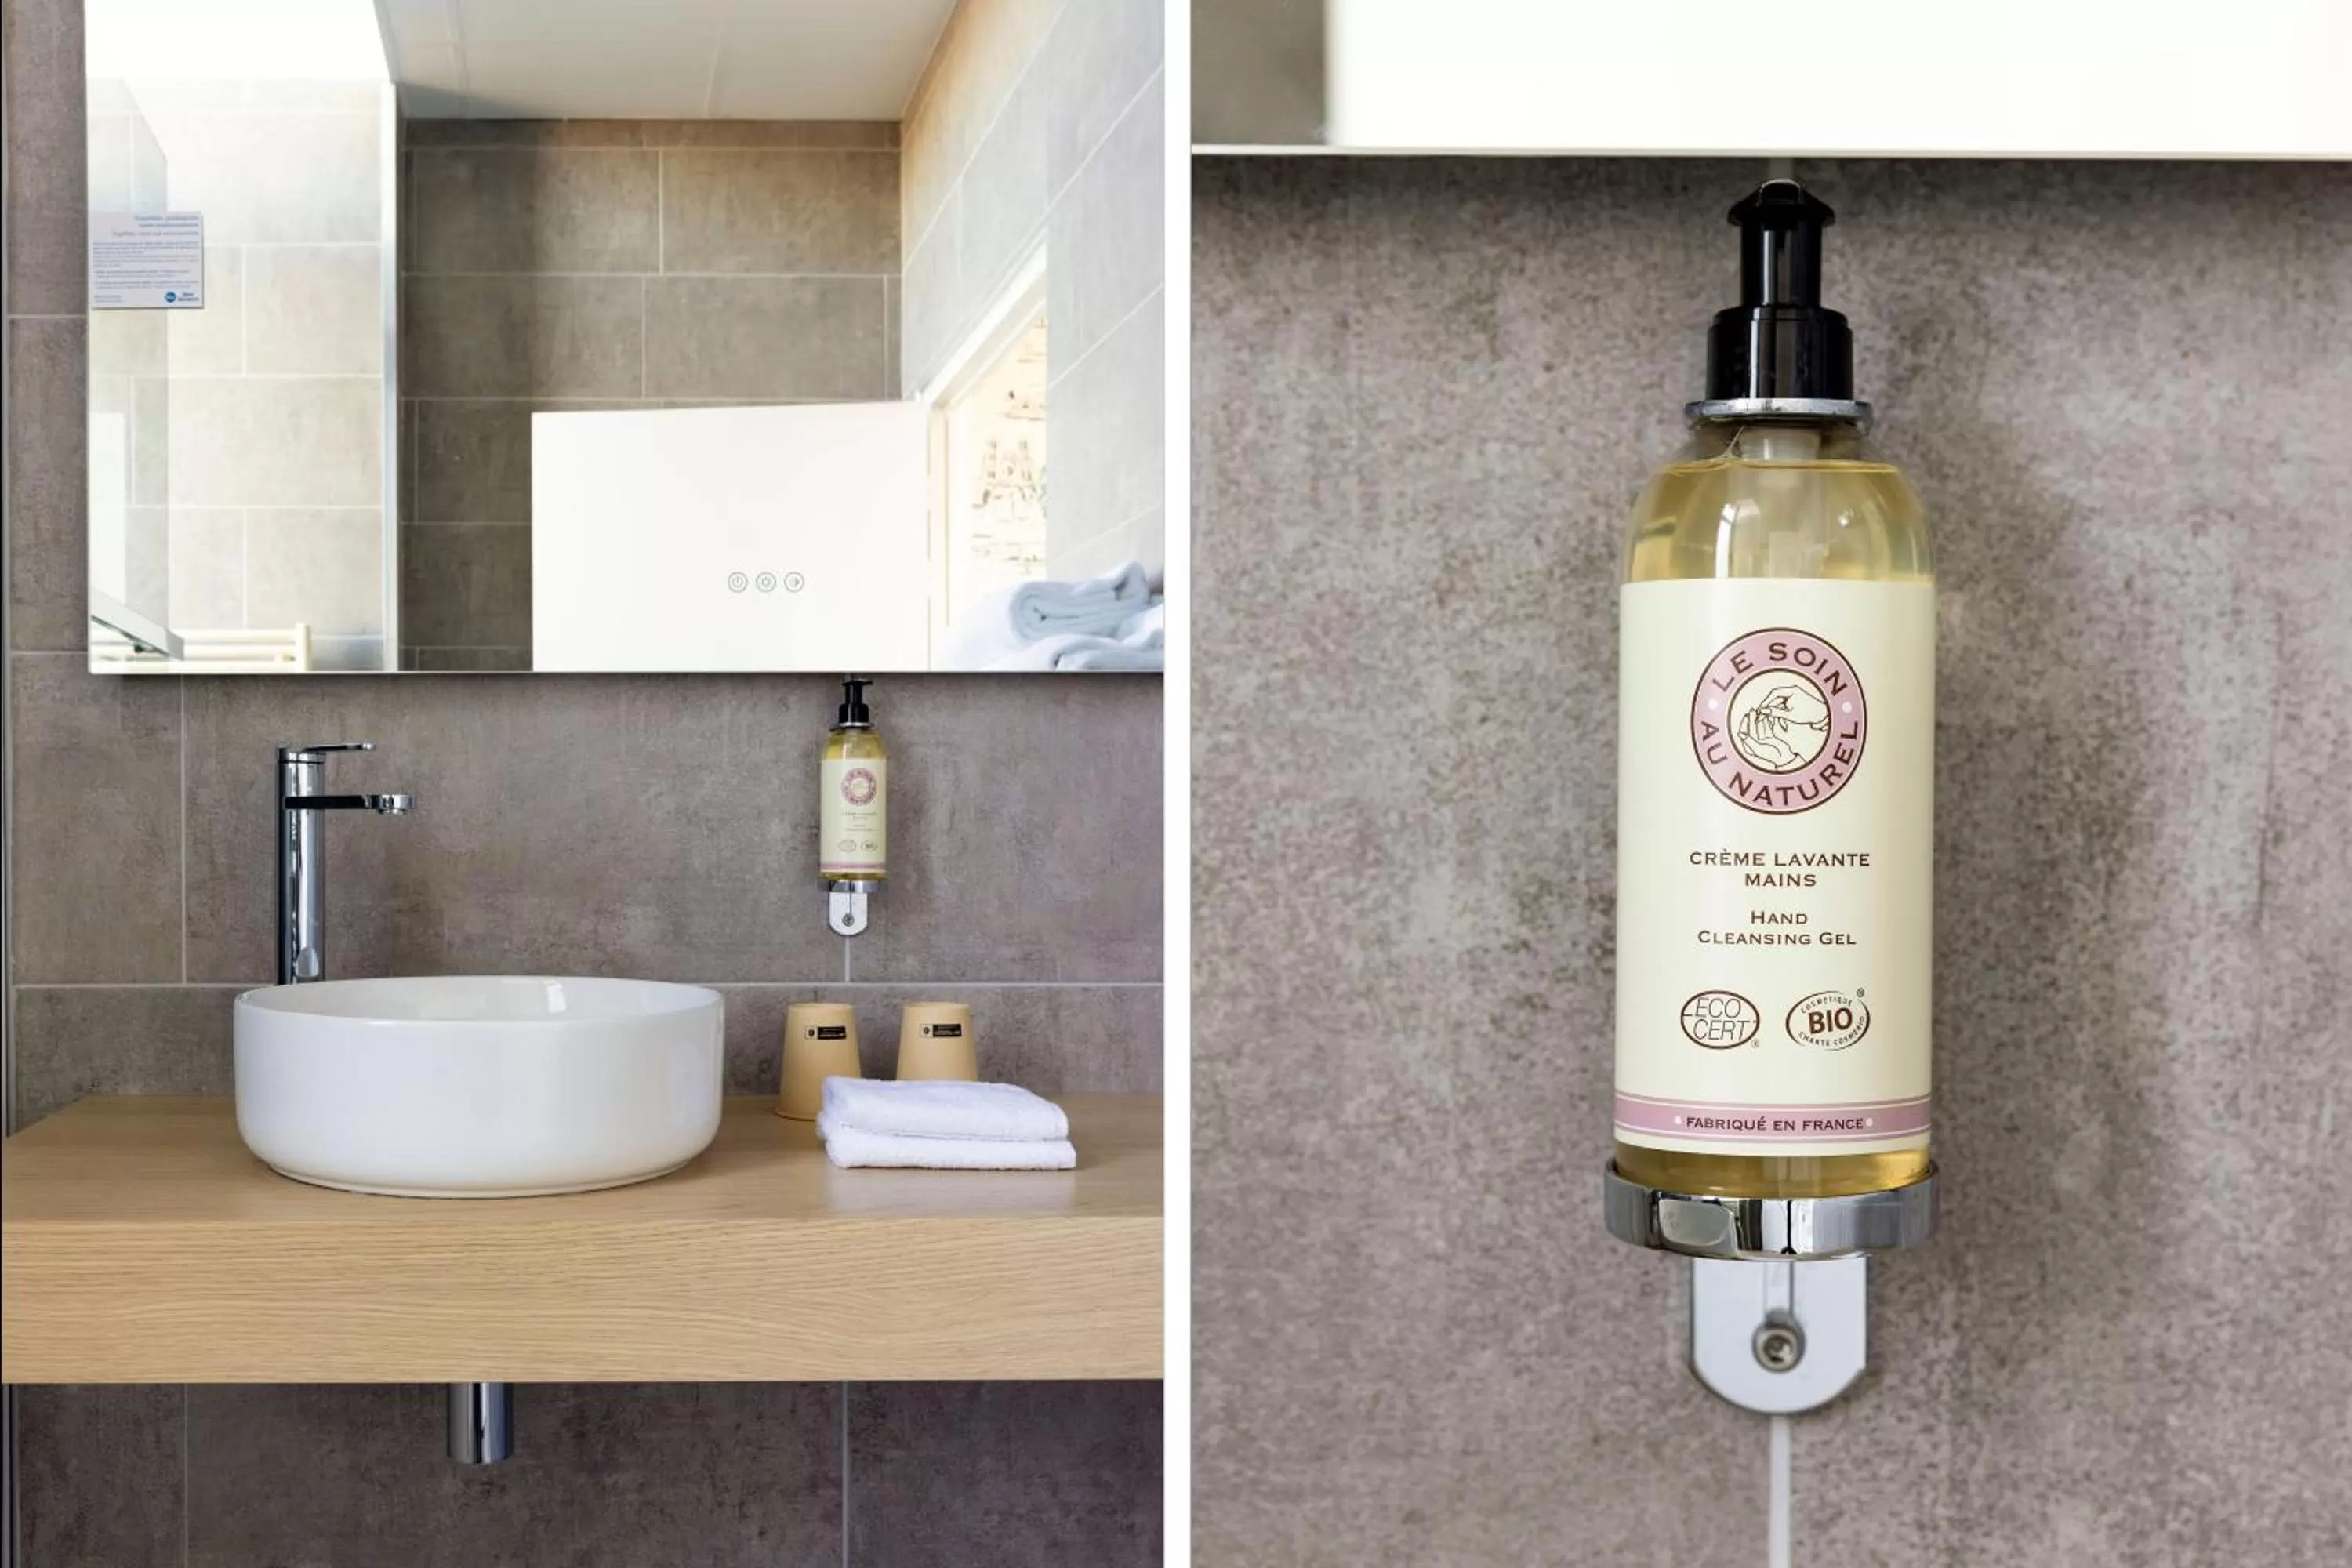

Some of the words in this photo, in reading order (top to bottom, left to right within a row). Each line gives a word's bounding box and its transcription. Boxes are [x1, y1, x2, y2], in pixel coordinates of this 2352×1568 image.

[1711, 650, 1754, 692] LE
[1768, 642, 1848, 696] SOIN
[1700, 720, 1727, 765] AU
[1728, 720, 1859, 807] NATUREL
[1690, 848, 1766, 866] CRÈME
[1774, 852, 1871, 866] LAVANTE
[1744, 873, 1817, 887] MAINS
[1694, 996, 1741, 1018] ECO
[1693, 1018, 1751, 1040] CERT
[1808, 1007, 1853, 1034] BIO
[1686, 1116, 1766, 1131] FABRIQUÉ
[1773, 1120, 1795, 1131] EN
[1802, 1117, 1864, 1131] FRANCE
